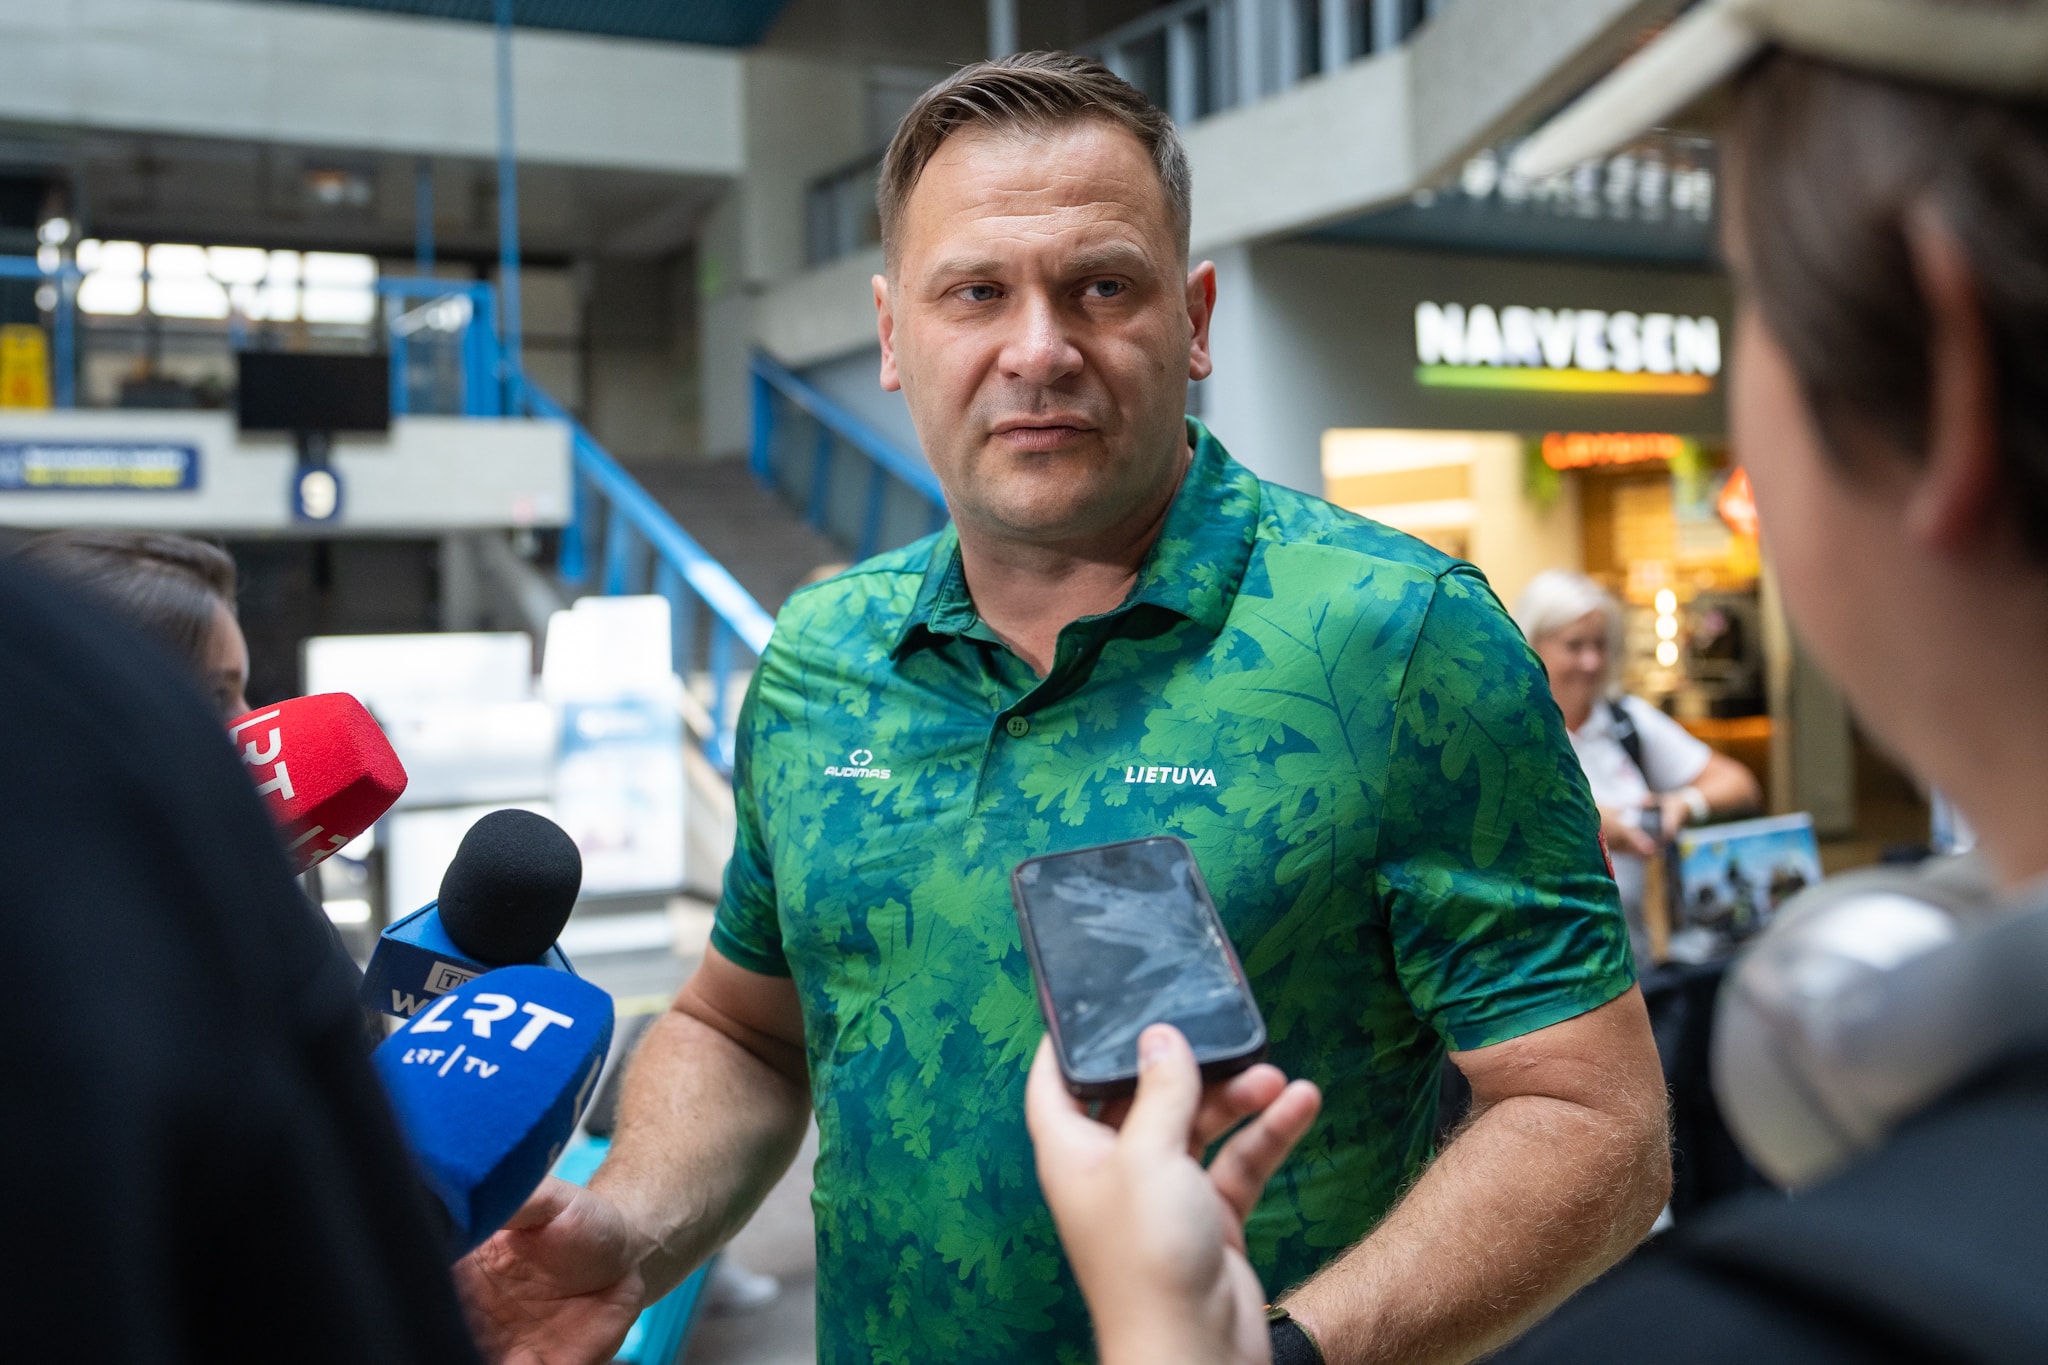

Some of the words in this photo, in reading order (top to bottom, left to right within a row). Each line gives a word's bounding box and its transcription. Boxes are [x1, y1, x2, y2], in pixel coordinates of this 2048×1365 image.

[1415, 301, 1721, 376] NARVESEN
[301, 471, 337, 519] 9
[824, 766, 891, 779] AUDIMAS
[1125, 766, 1217, 786] LIETUVA
[409, 993, 574, 1051] LRT
